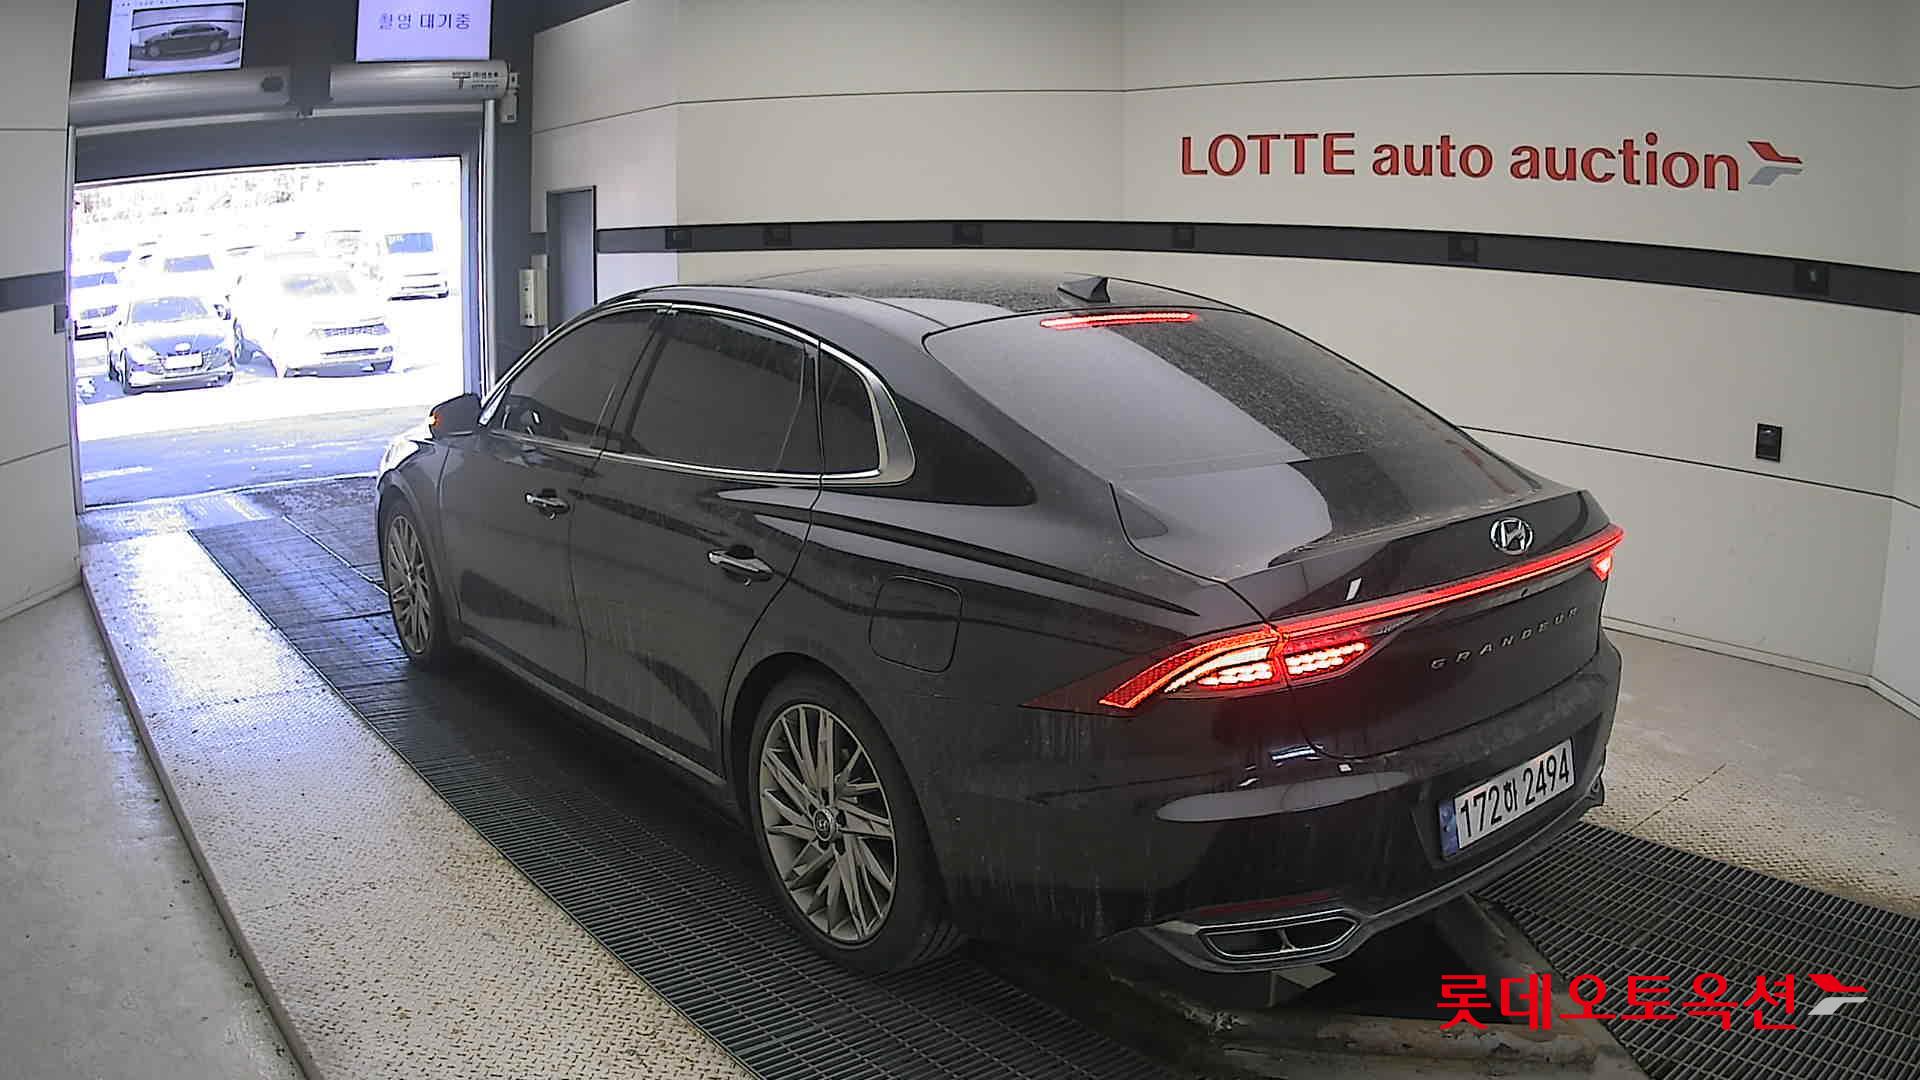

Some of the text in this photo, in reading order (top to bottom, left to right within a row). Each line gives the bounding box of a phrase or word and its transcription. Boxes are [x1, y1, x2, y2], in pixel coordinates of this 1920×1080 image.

[420, 13, 471, 30] 대기중
[1181, 131, 1740, 191] LOTTE auto auction
[1430, 607, 1578, 670] GRANDEUR
[1522, 747, 1570, 806] 2494
